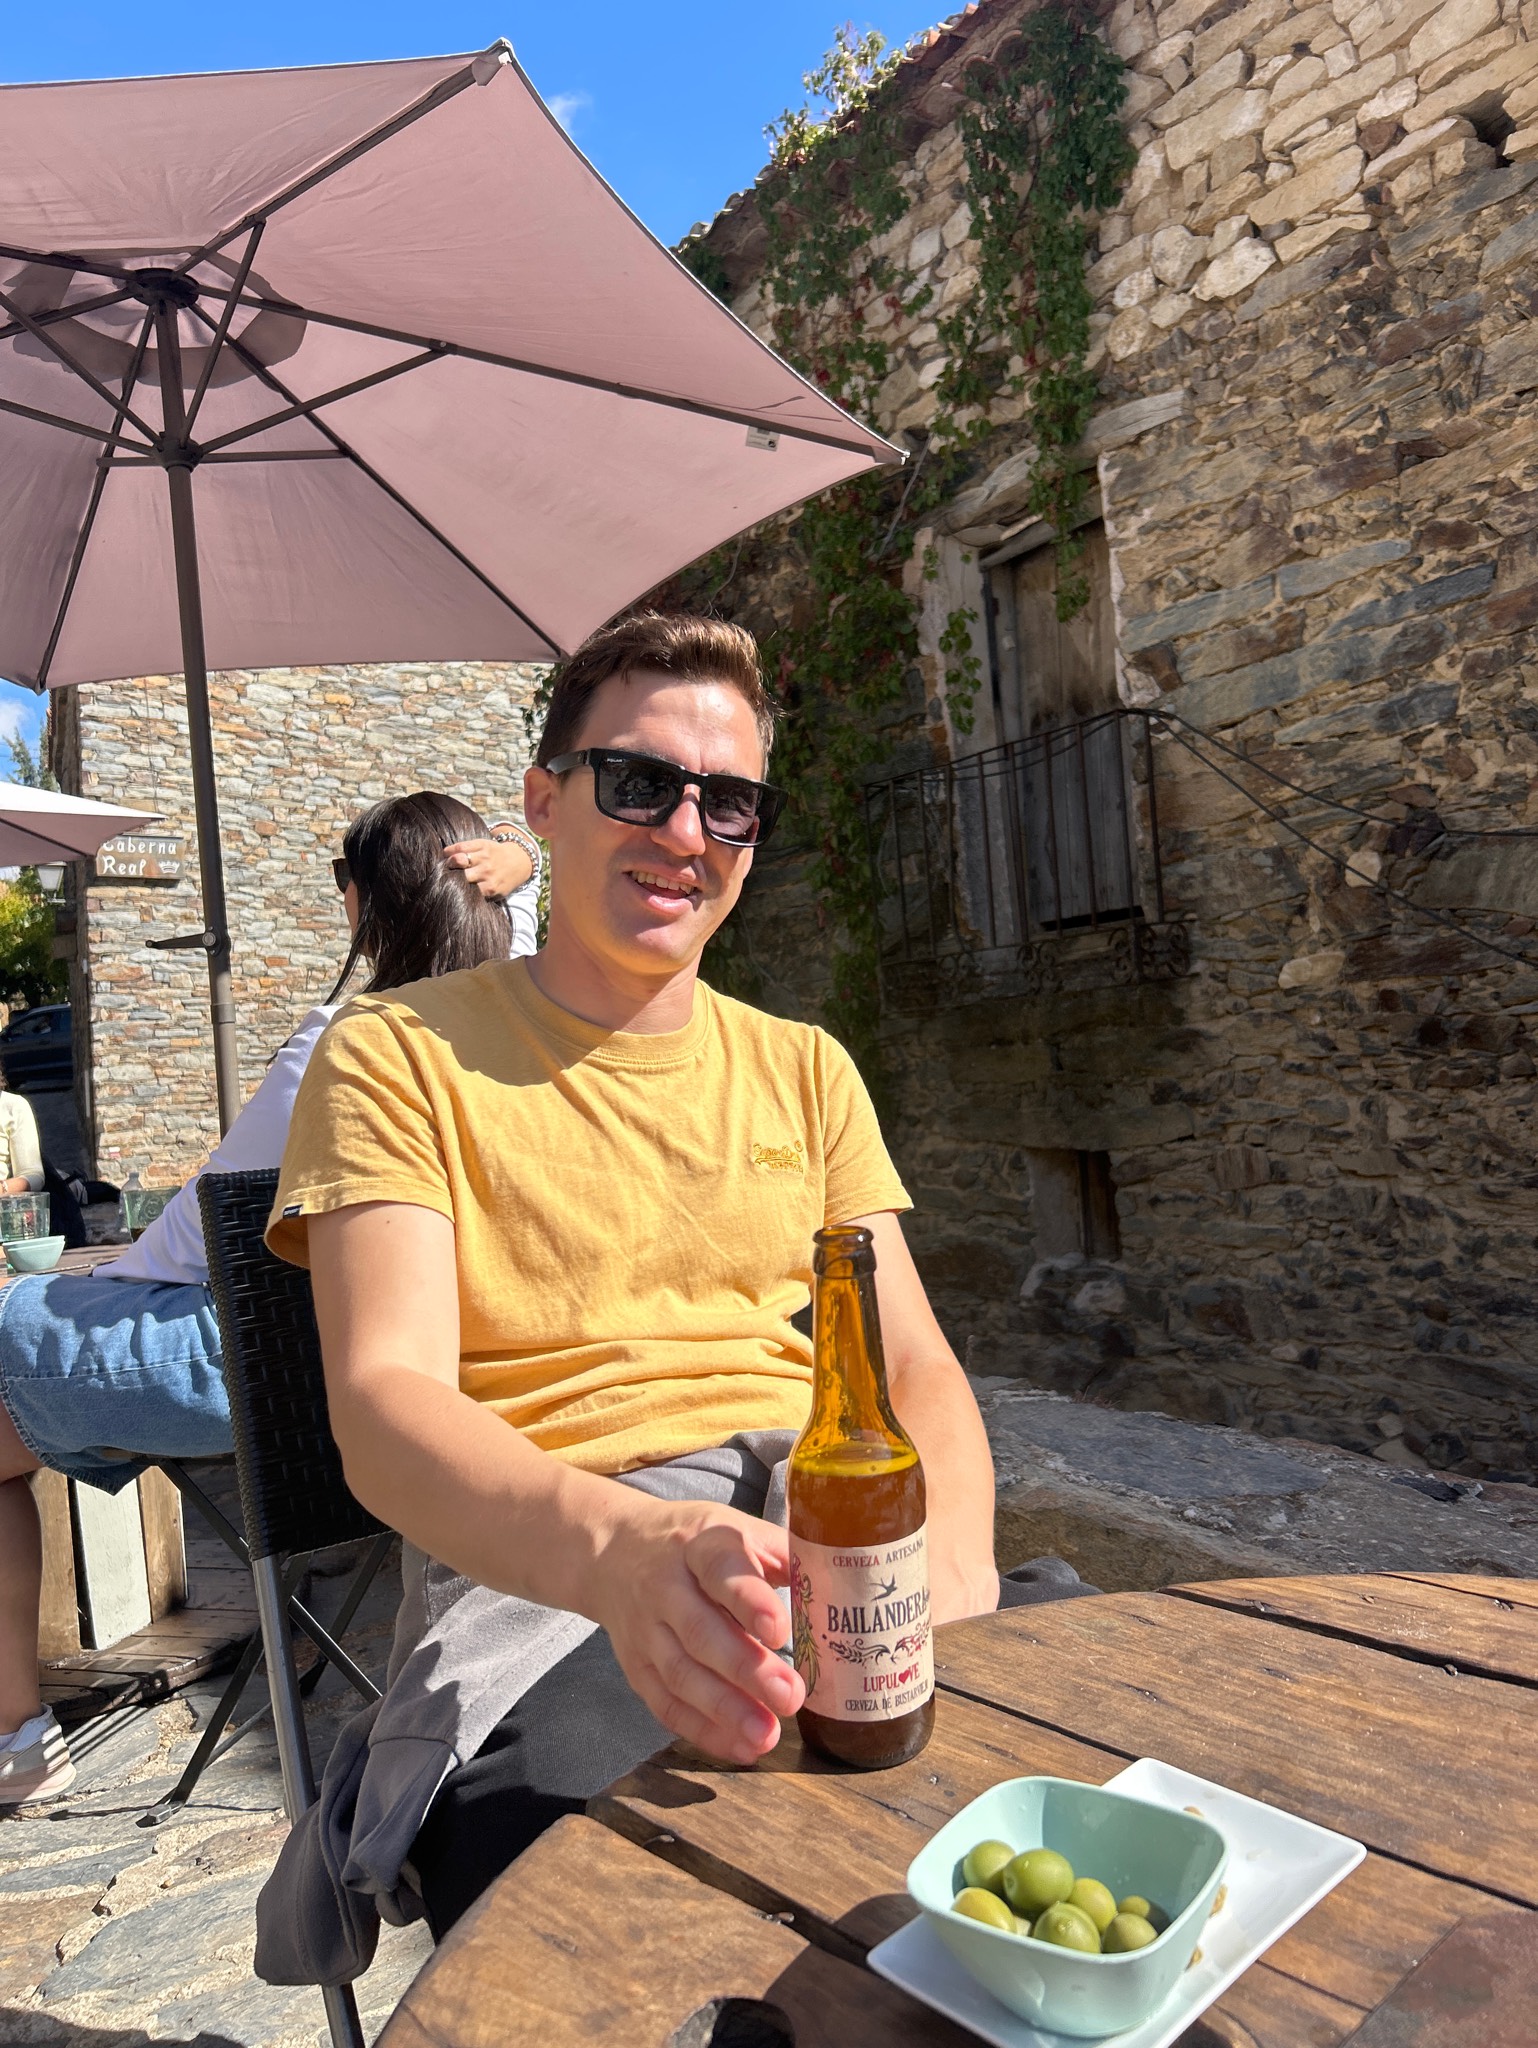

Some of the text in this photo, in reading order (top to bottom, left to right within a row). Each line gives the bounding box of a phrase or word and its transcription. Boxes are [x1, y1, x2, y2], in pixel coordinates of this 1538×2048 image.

[102, 855, 147, 875] Real
[832, 1555, 880, 1567] CERVEZA
[845, 1699, 879, 1711] CERVEZA
[882, 1697, 893, 1710] DE
